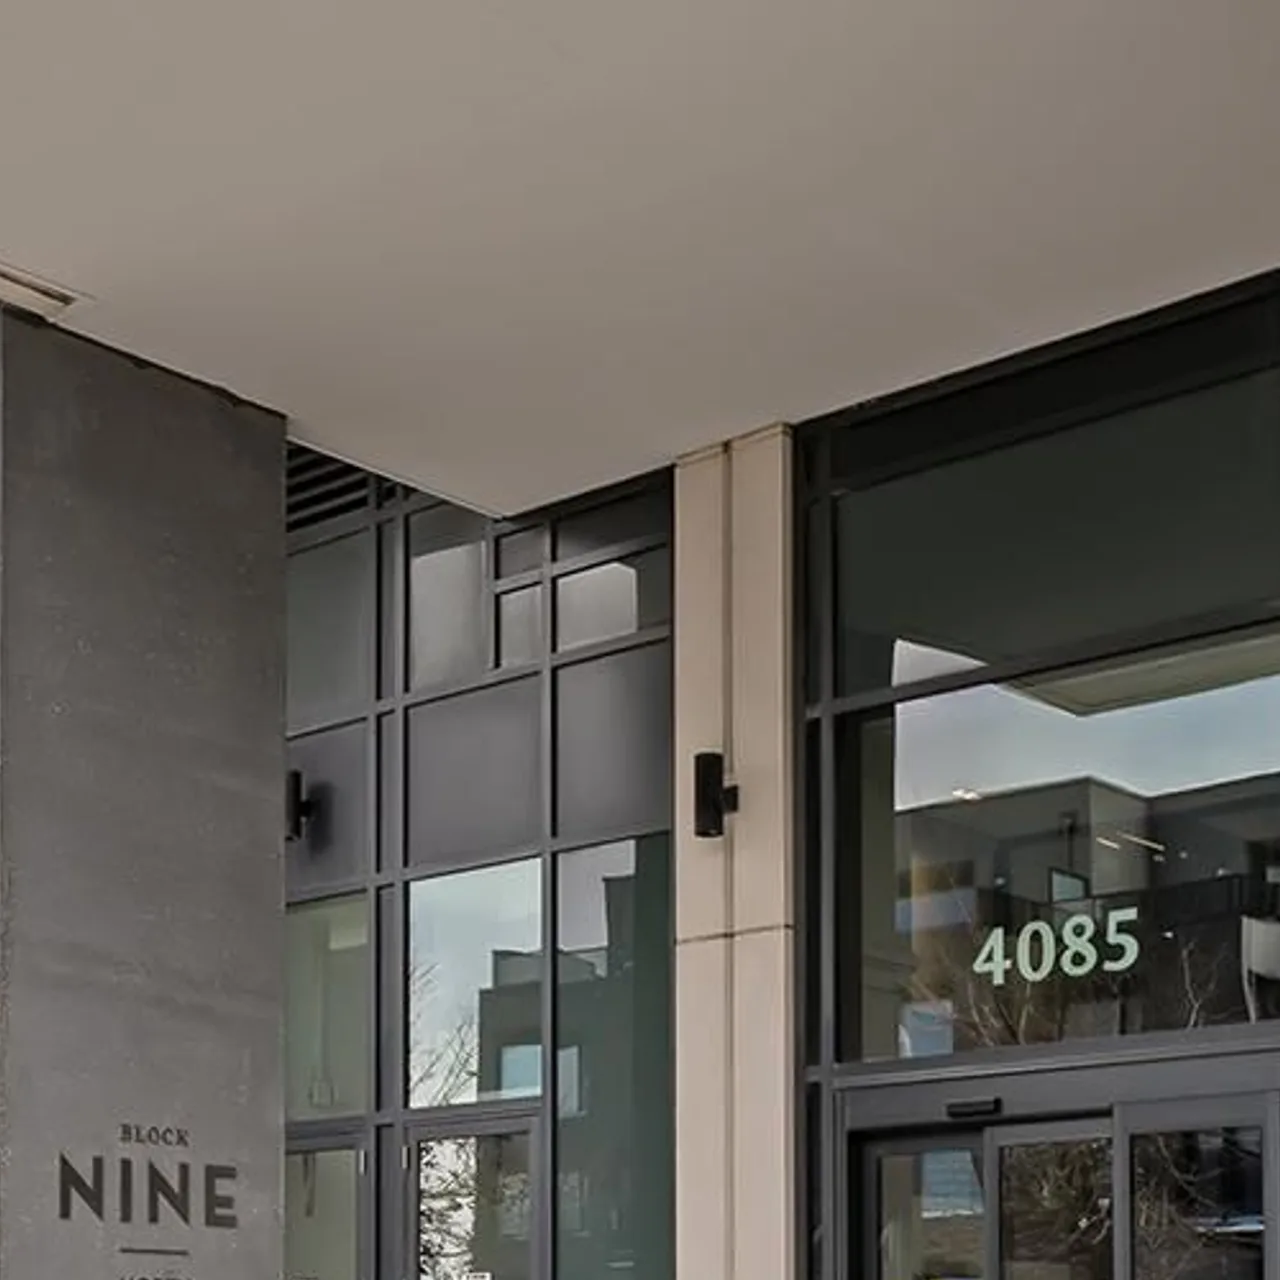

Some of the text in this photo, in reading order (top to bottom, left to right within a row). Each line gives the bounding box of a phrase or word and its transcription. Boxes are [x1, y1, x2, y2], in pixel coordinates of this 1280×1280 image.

[973, 907, 1139, 985] 4085
[120, 1124, 189, 1147] BLOCK
[59, 1151, 238, 1229] NINE
